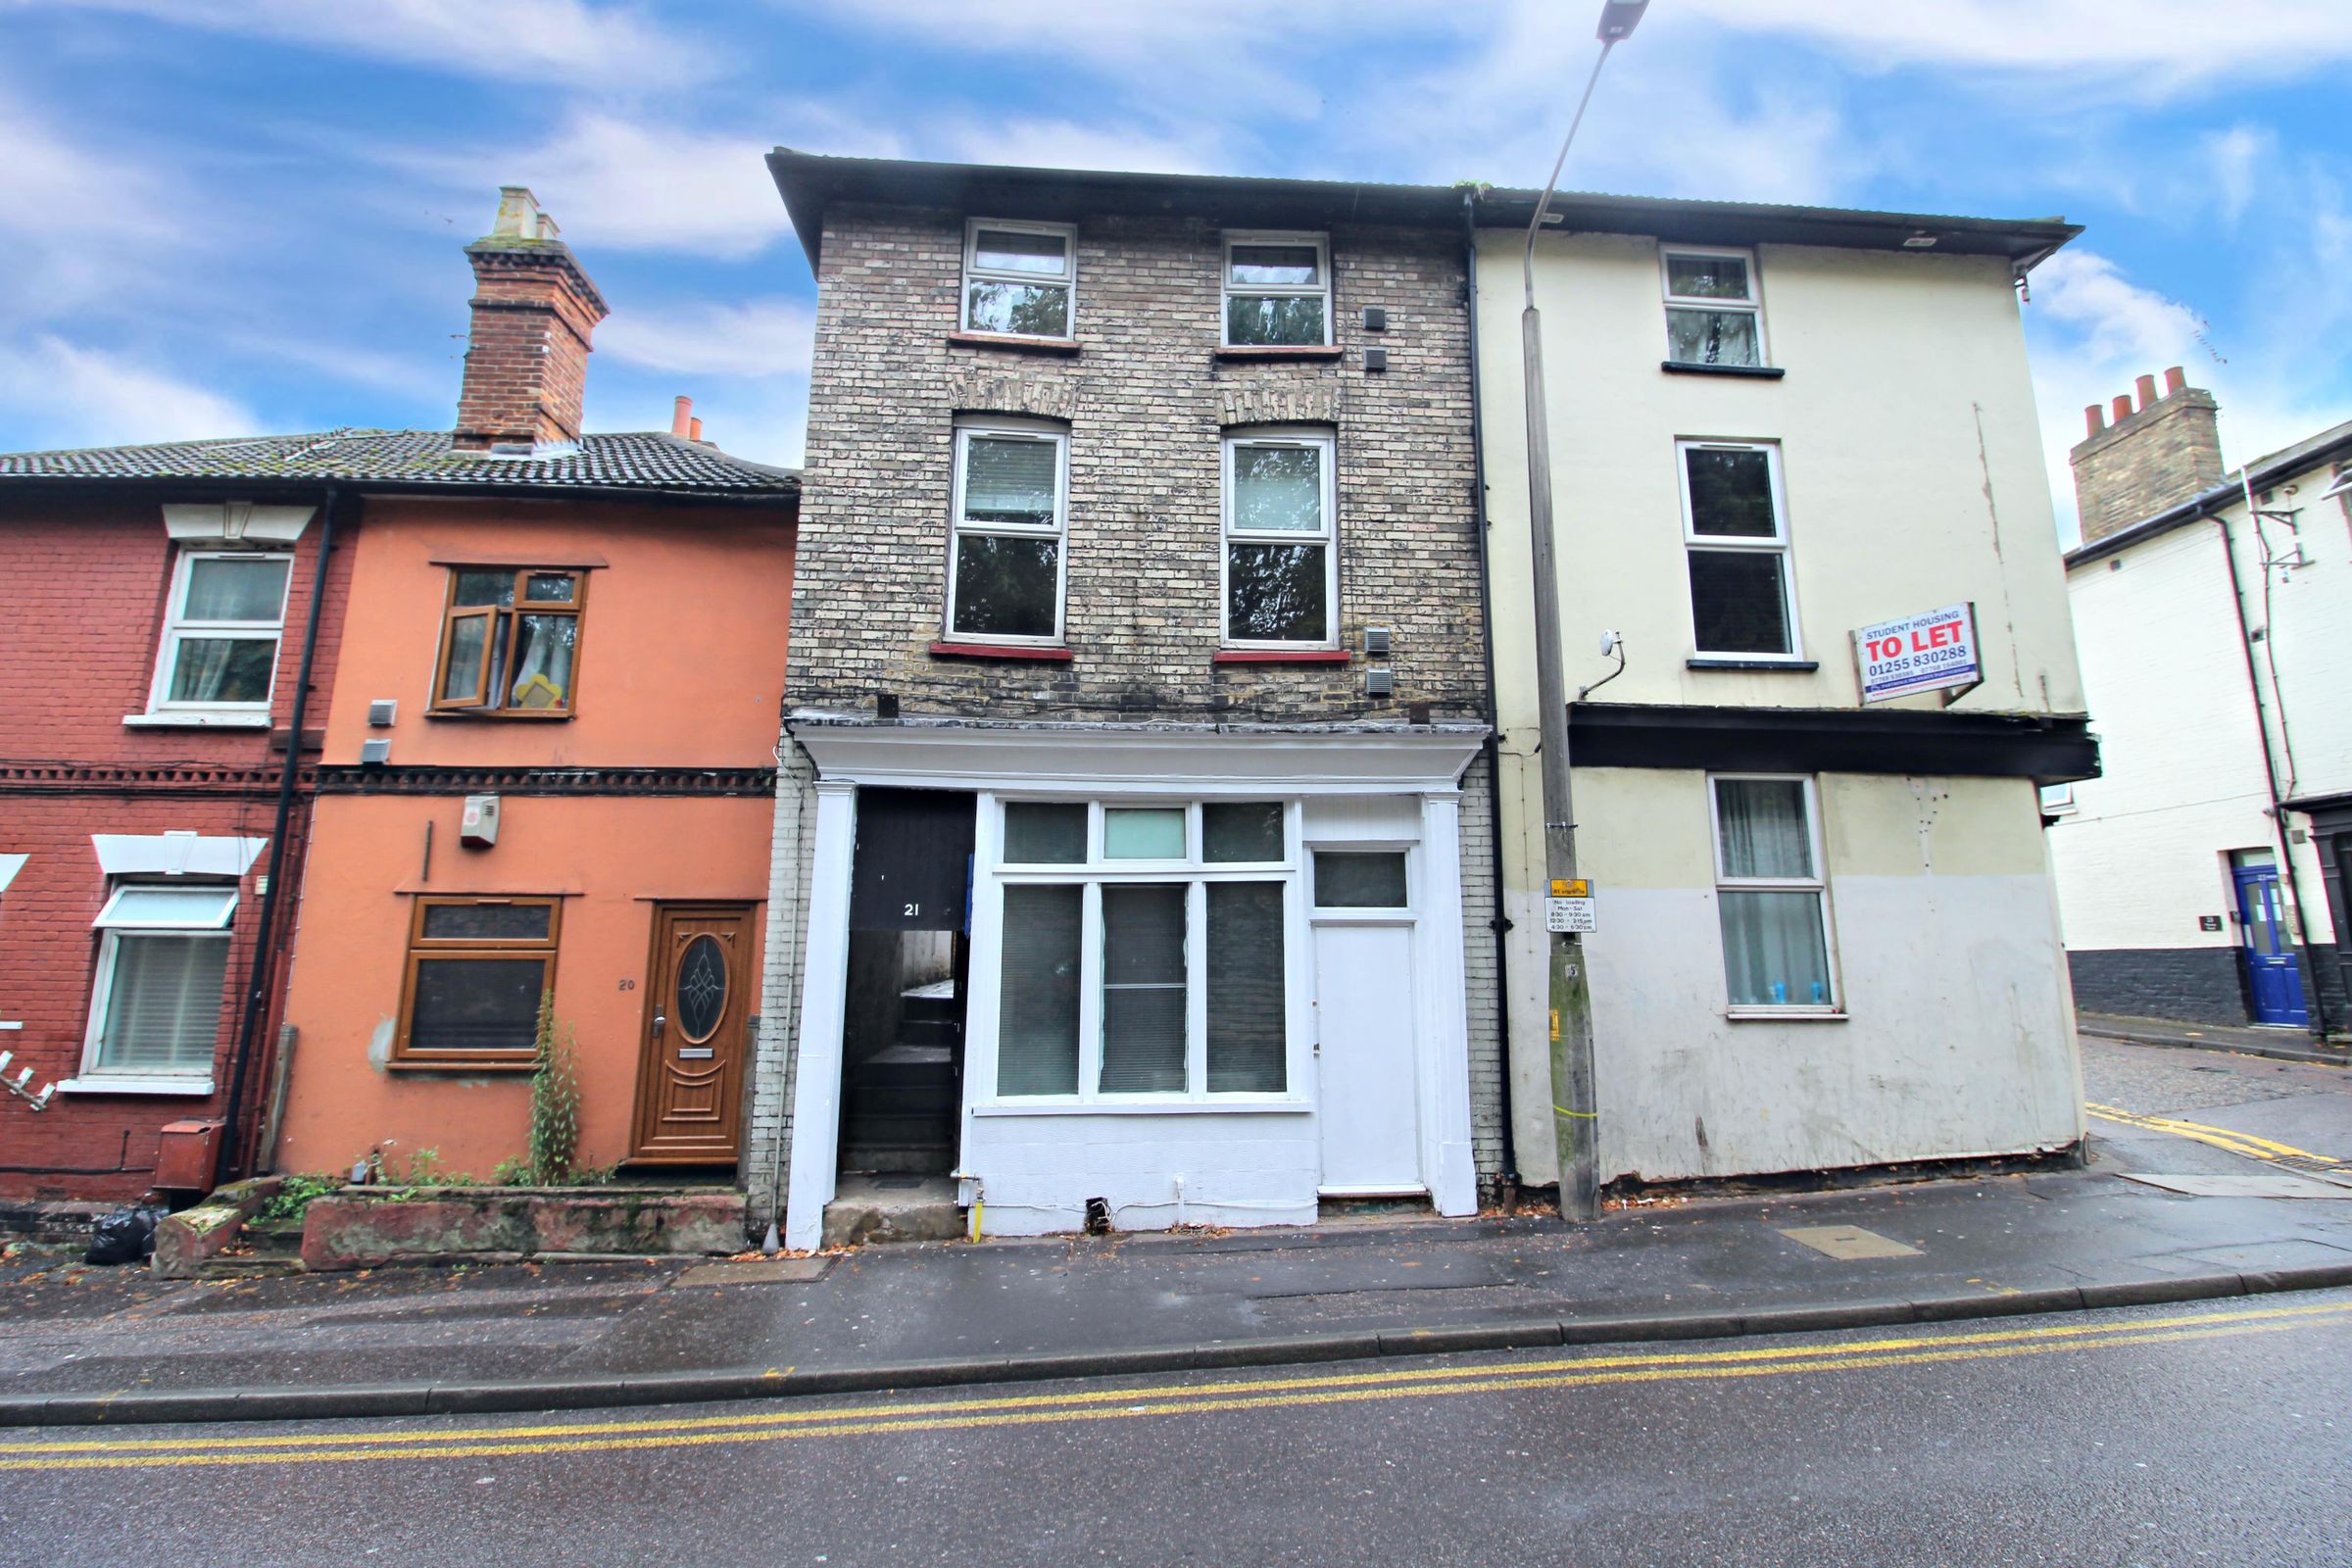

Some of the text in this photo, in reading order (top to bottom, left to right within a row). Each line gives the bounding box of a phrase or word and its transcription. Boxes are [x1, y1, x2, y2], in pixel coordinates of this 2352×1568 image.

[1867, 611, 1959, 640] STUDENT HOUSING
[1866, 619, 1963, 662] TO LET
[1869, 645, 1967, 676] 01255 830288
[905, 904, 919, 916] 21
[619, 980, 635, 990] 20
